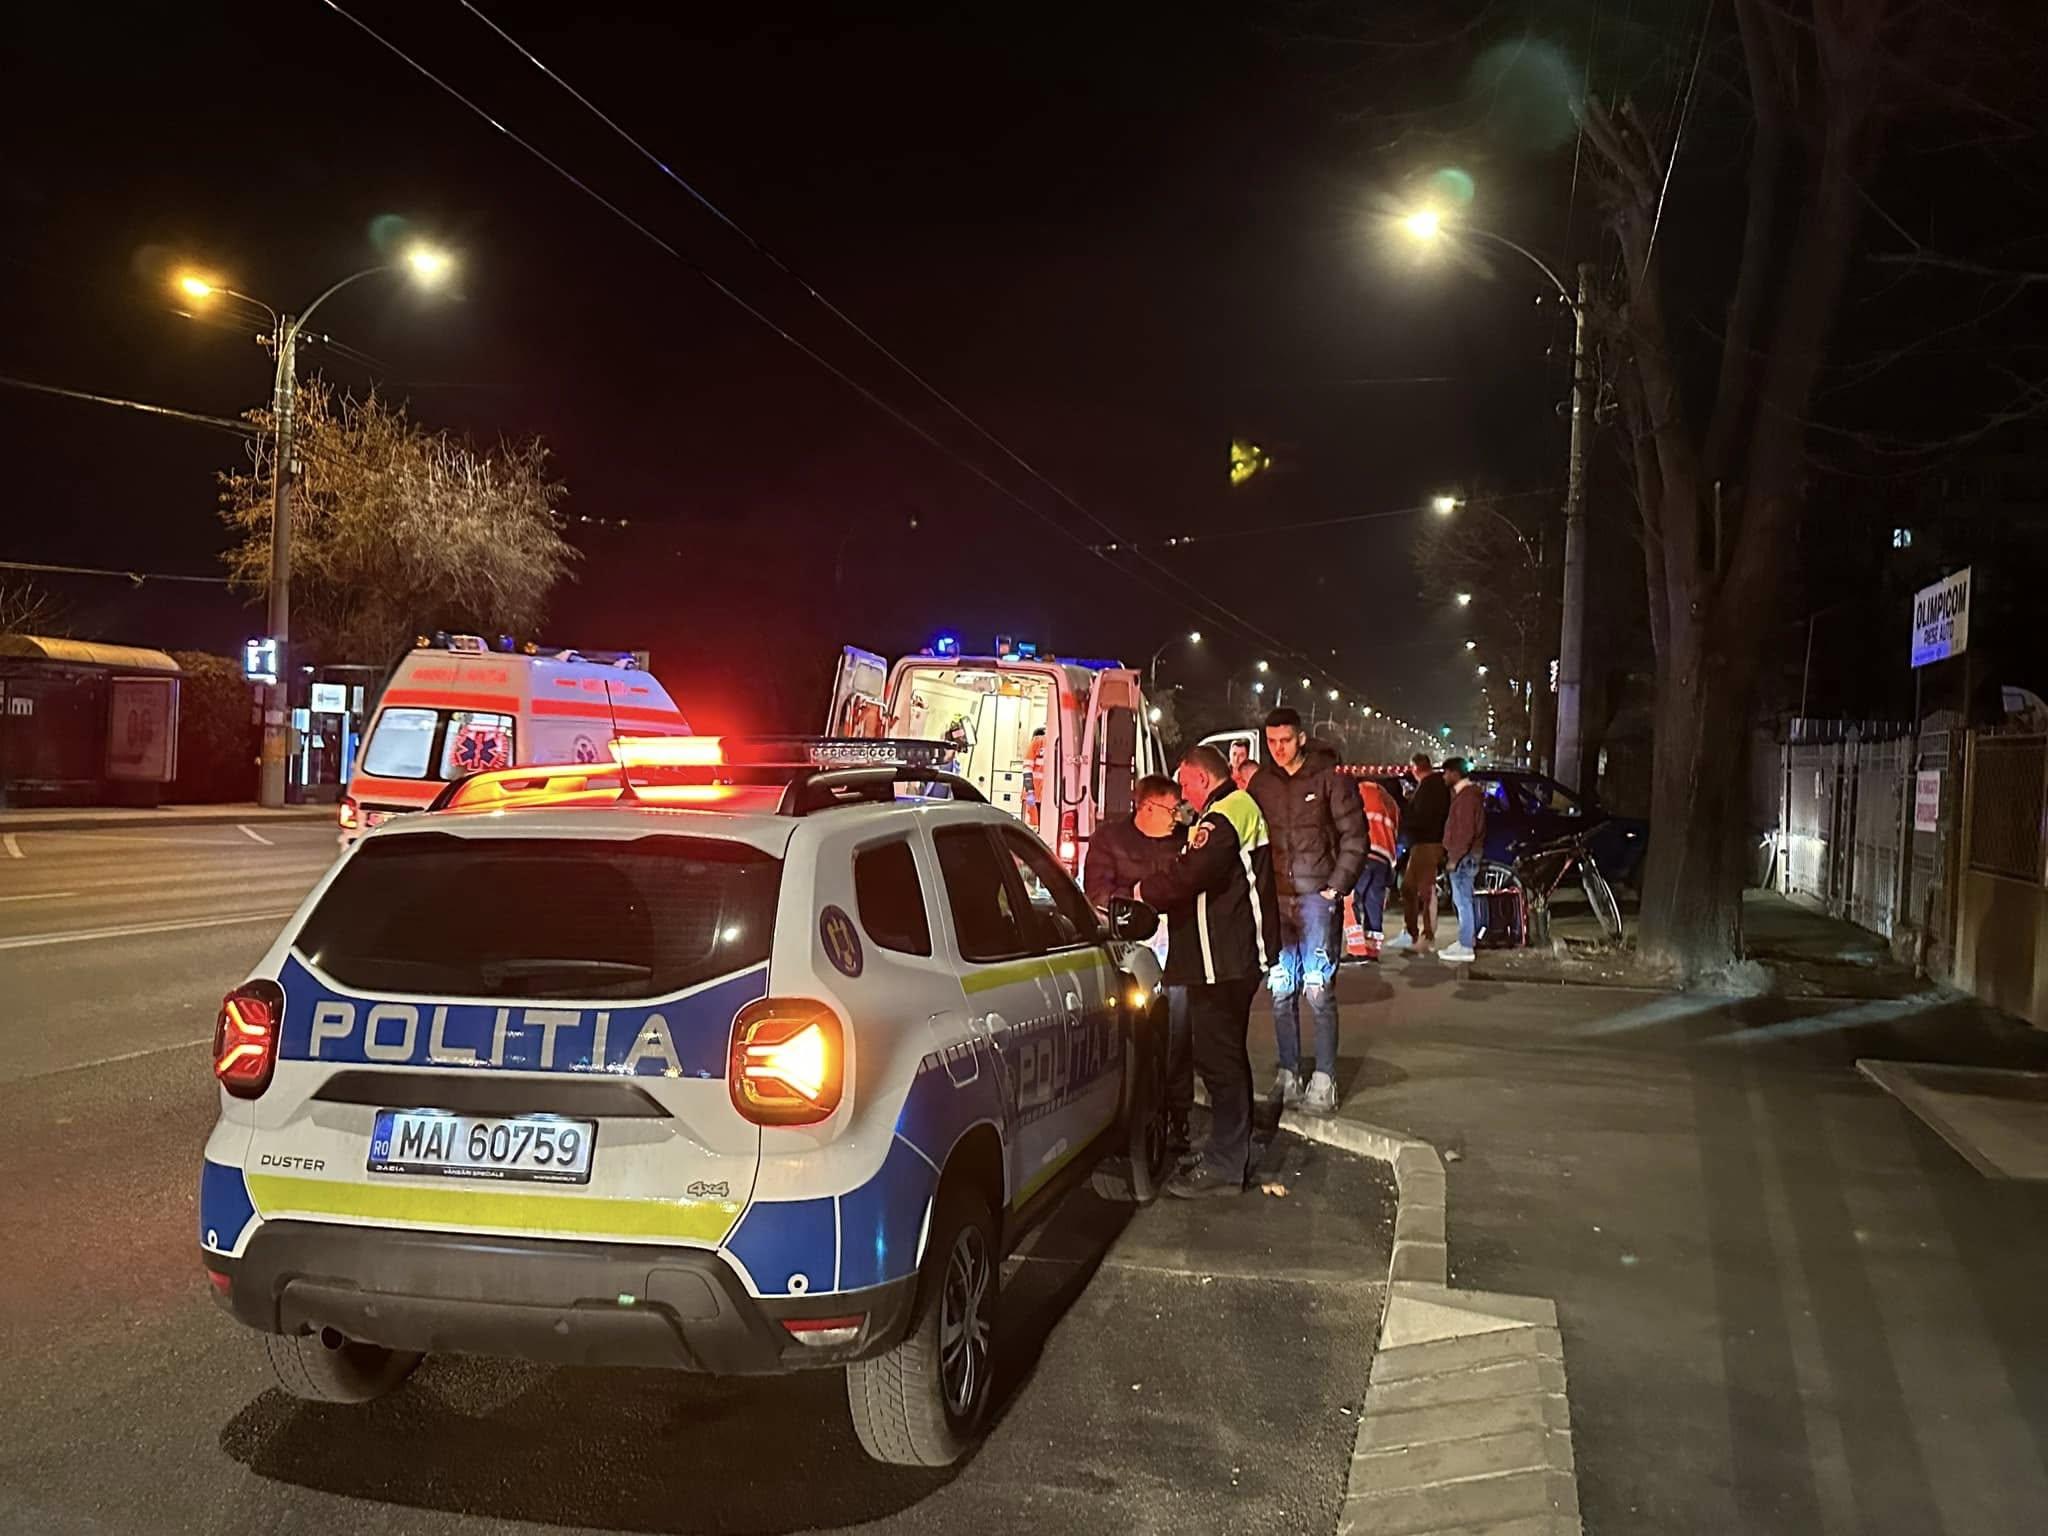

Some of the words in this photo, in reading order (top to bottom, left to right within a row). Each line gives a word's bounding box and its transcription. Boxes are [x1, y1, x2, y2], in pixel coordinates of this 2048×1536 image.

[1916, 581, 1967, 630] OLIMPICOM
[309, 1001, 683, 1077] POLITIA
[373, 1140, 389, 1156] RO
[400, 1120, 457, 1161] MAI
[468, 1123, 581, 1166] 60759
[261, 1154, 325, 1171] DUSTER
[687, 1181, 729, 1197] 4x4
